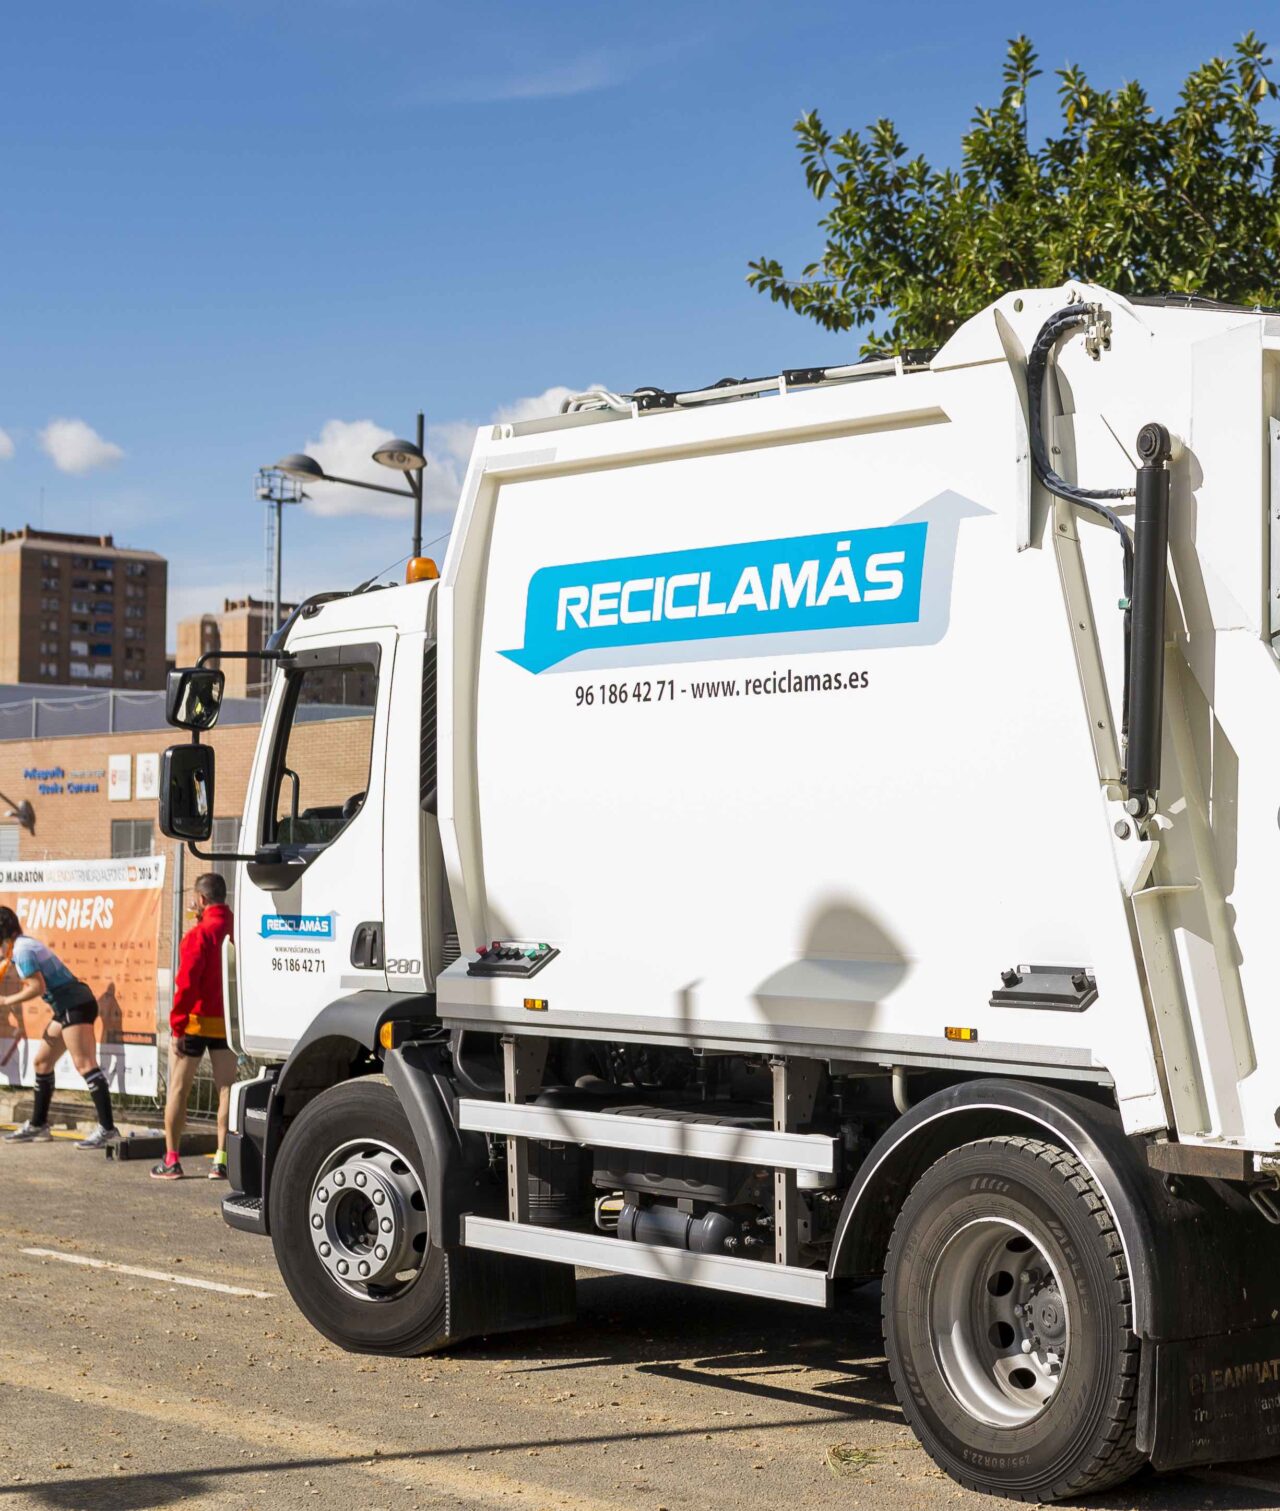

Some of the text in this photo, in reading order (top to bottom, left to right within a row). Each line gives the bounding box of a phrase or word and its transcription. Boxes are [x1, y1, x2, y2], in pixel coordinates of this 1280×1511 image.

[555, 540, 905, 631] RECICLAMÁS
[575, 685, 595, 706] 96
[599, 682, 628, 705] 186
[632, 681, 652, 702] 42
[656, 679, 675, 701] 71
[691, 678, 740, 699] www.
[745, 669, 869, 695] reciclamas.es
[6, 868, 44, 883] MARATÓN
[15, 895, 115, 932] FINISHERS
[266, 917, 329, 932] RECICLAMÁS
[272, 958, 326, 973] 96 186 42 71
[386, 958, 421, 975] 280
